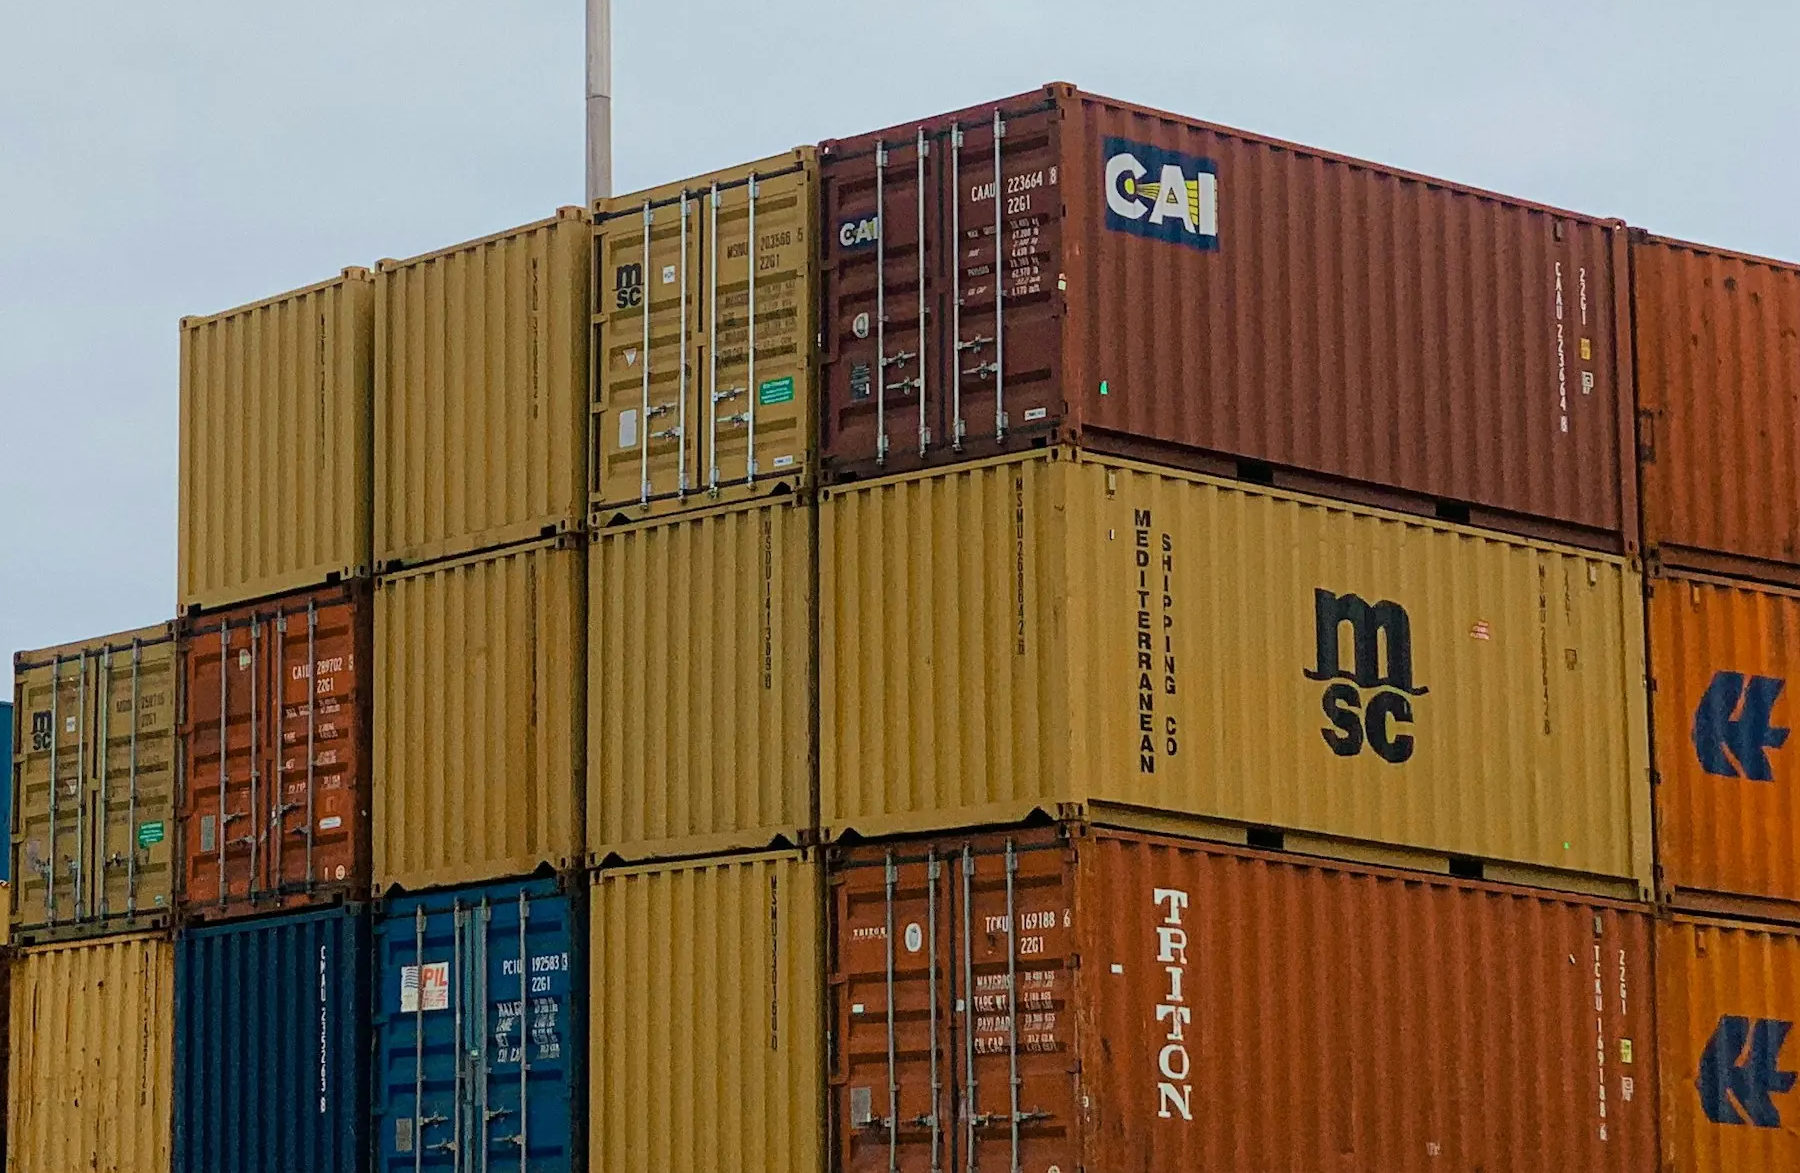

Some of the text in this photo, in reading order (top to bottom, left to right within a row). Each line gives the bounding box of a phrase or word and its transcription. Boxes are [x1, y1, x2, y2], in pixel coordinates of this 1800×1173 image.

[971, 166, 1057, 202] CAAU 223664 8
[1105, 152, 1216, 236] CAI
[1007, 194, 1030, 215] 22G1
[839, 217, 879, 246] CAI
[1555, 261, 1563, 320] CAAU
[1579, 267, 1588, 326] 22G1
[1557, 324, 1567, 411] 223664
[1134, 509, 1154, 775] MEDITERRANEAN
[1161, 533, 1178, 756] SHIPPING CO
[1021, 911, 1056, 930] 169188
[1021, 936, 1044, 954] 22G1
[422, 968, 447, 987] PIL
[503, 959, 524, 975] PCIU
[531, 954, 560, 972] 192583
[531, 976, 551, 992] 22G1
[1154, 888, 1193, 1121] TRITON
